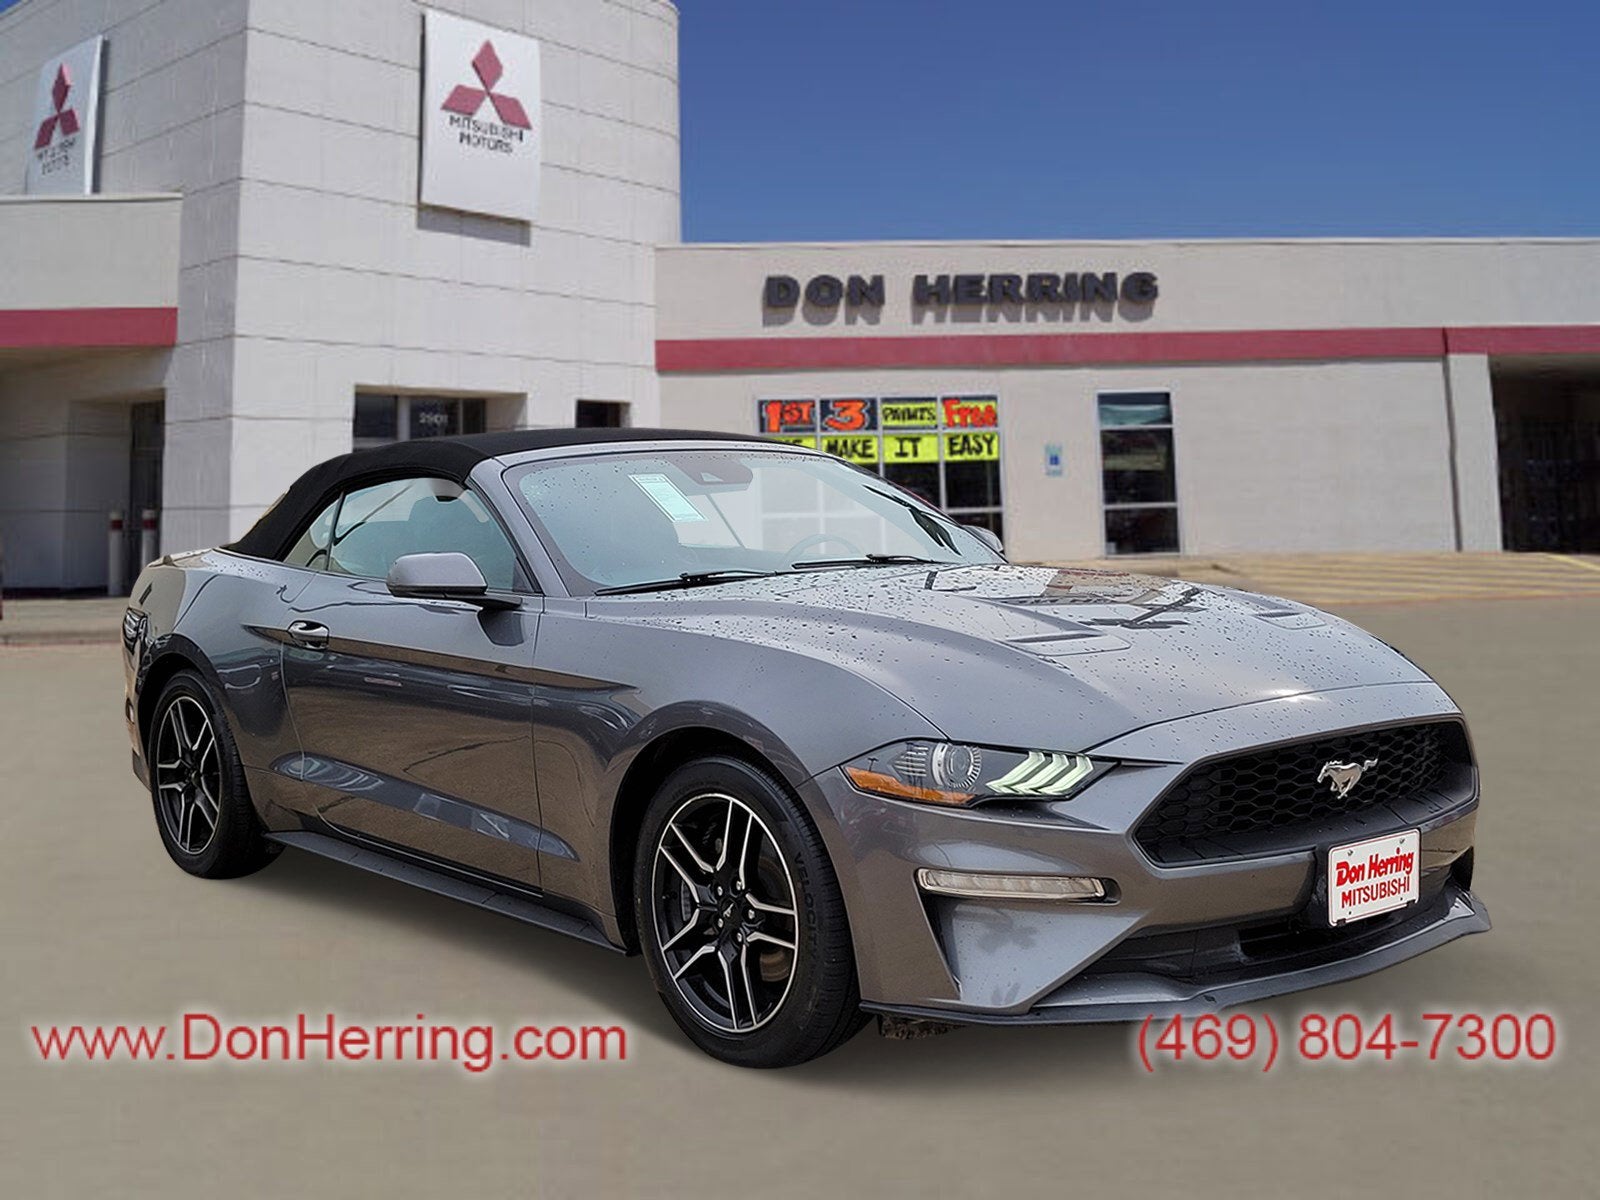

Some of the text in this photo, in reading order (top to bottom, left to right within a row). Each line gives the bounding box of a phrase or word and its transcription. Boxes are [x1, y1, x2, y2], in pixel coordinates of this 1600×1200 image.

[459, 132, 514, 153] MOTORS
[763, 272, 1159, 308] DON HERRING
[766, 400, 815, 432] 1ST
[825, 400, 866, 431] 3
[942, 398, 997, 428] Free
[826, 434, 994, 458] MAKE IT EASY
[1336, 847, 1414, 887] Don Herring
[1341, 876, 1410, 909] MITSUBISHI
